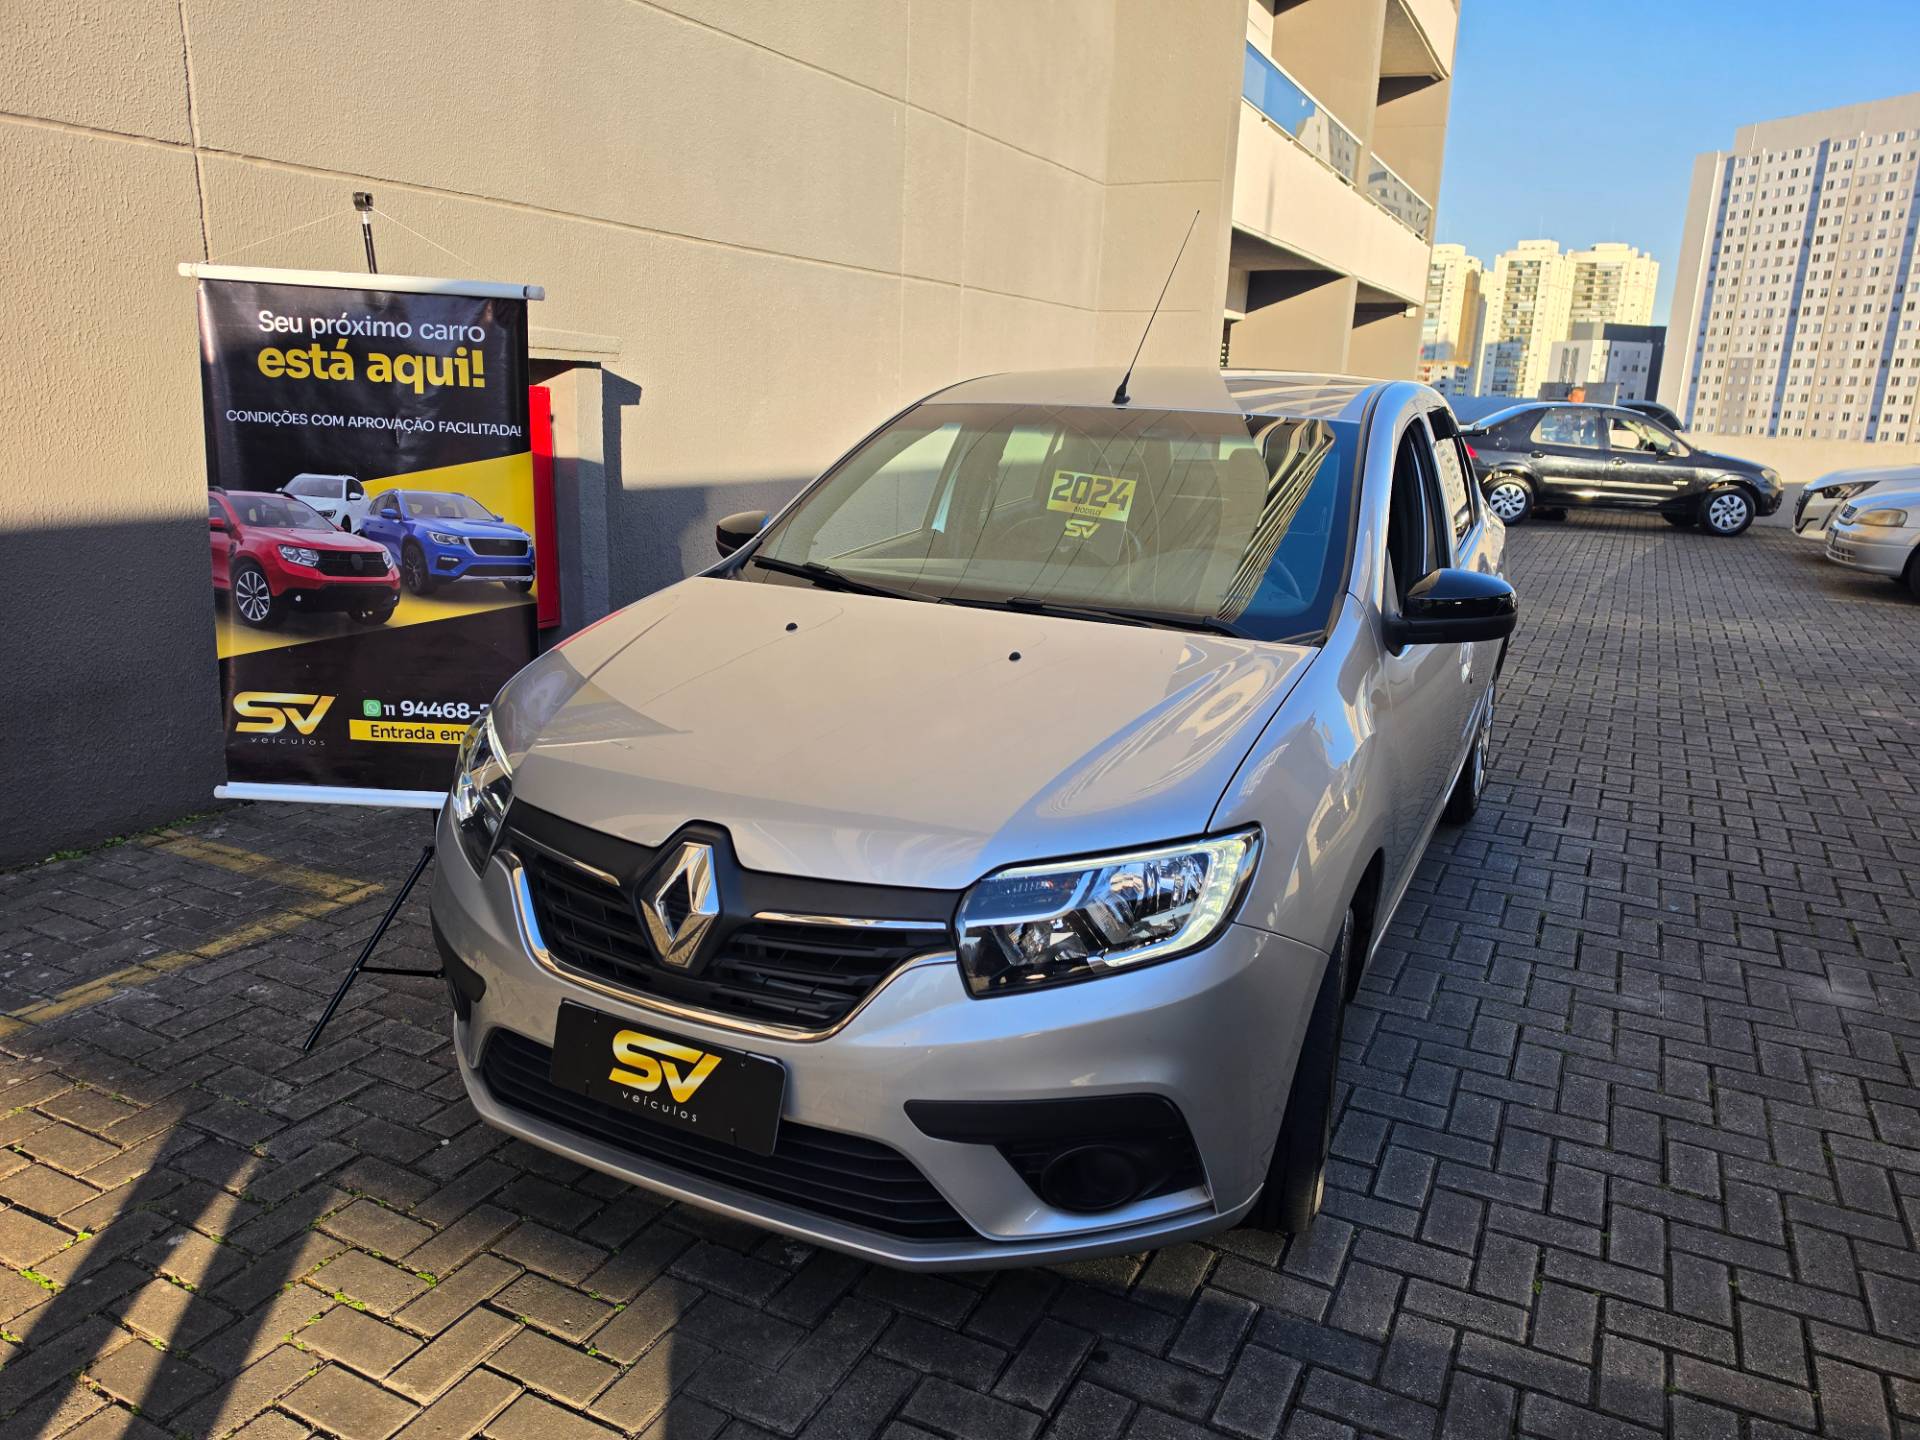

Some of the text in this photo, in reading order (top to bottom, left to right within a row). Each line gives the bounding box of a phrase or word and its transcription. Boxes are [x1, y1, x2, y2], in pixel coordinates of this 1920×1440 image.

[258, 310, 486, 343] Seu próximo carro
[257, 339, 486, 394] está aqui!
[226, 409, 523, 437] CONDIÇÕES COM APROVAÇÃO FACILITADA!
[1051, 473, 1130, 511] 2024
[1063, 518, 1101, 540] SV
[232, 691, 337, 735] SV
[384, 704, 396, 716] 11
[370, 724, 435, 740] Entrada
[608, 1029, 722, 1103] SV
